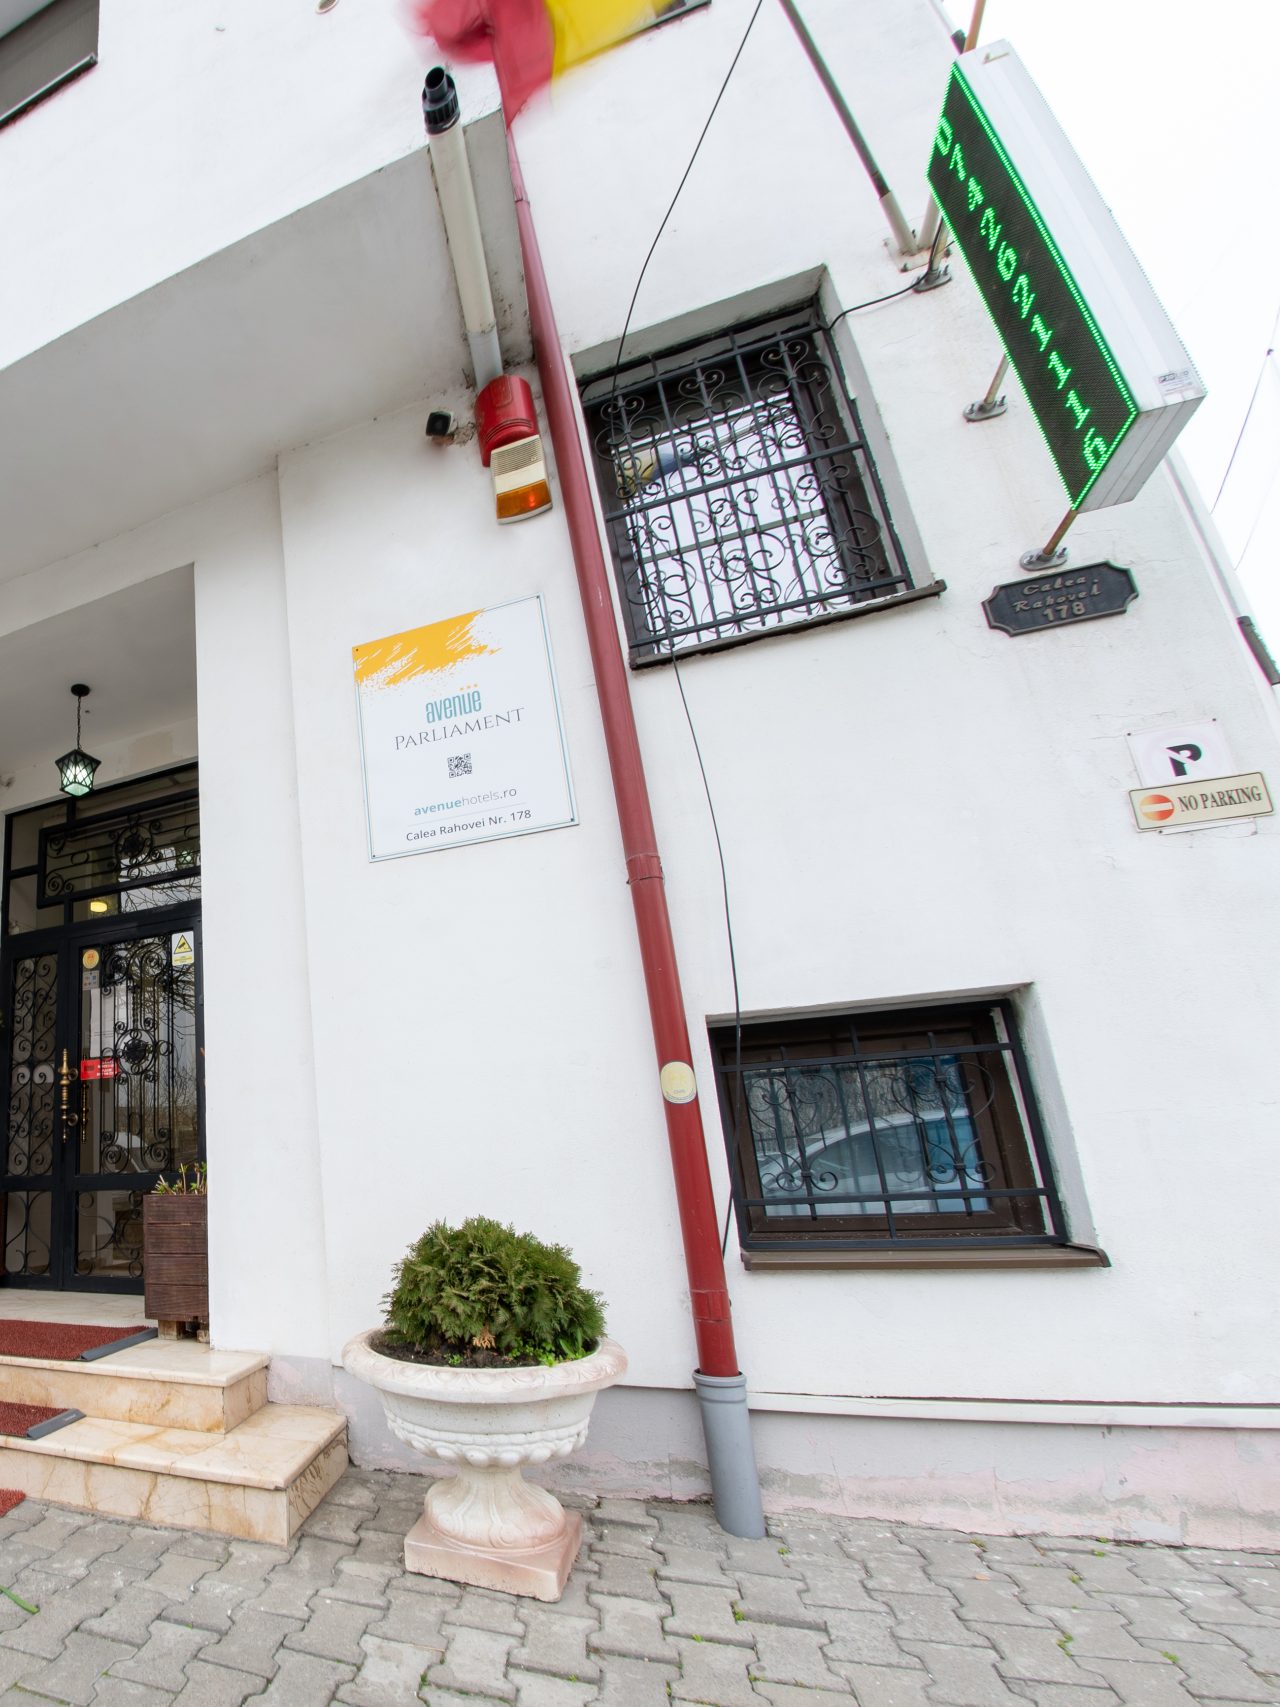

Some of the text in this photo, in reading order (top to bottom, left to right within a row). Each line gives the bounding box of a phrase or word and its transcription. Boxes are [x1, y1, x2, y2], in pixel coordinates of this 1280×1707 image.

[1011, 579, 1101, 612] Rahovei
[1023, 577, 1087, 594] Calea
[1043, 602, 1086, 622] 178
[425, 690, 482, 724] avenue
[394, 707, 524, 750] PARLIAMENT
[1166, 743, 1202, 777] P
[414, 788, 517, 816] avenuehotels.ro
[1178, 786, 1262, 812] NO PARKING
[406, 809, 532, 841] Calea Rahovei Nr. 178
